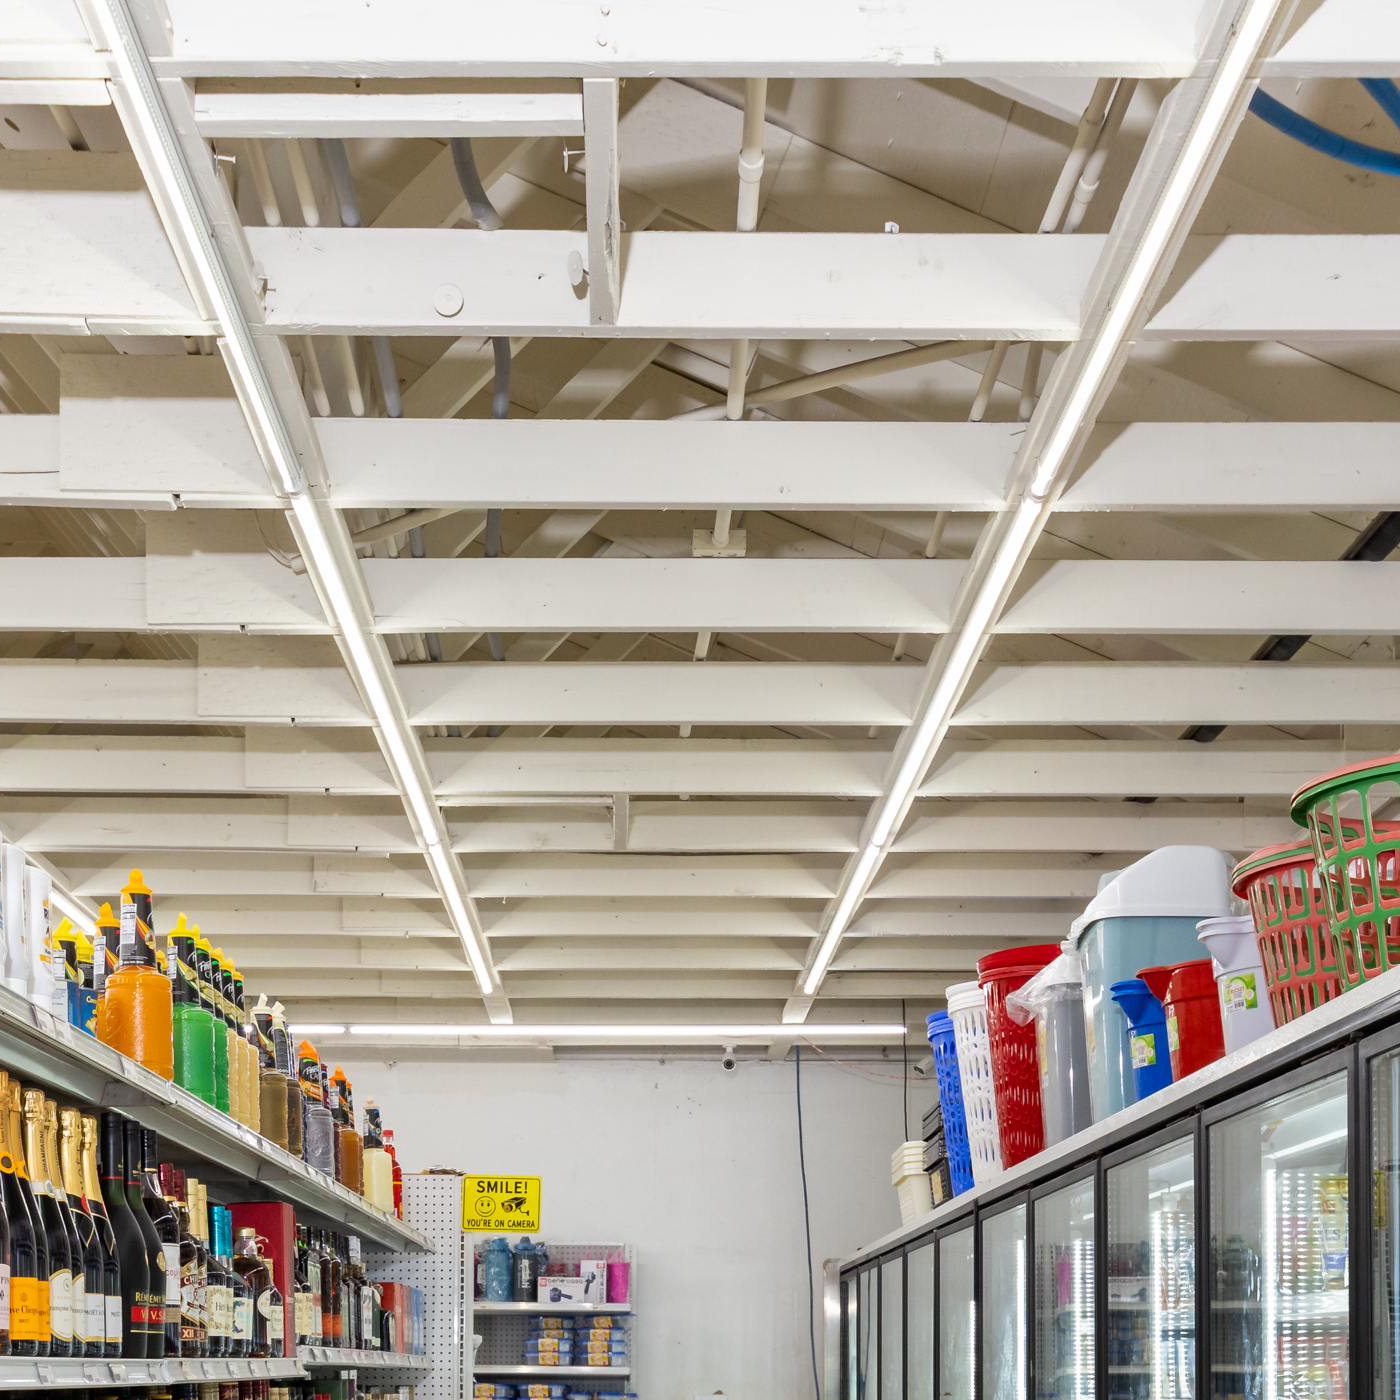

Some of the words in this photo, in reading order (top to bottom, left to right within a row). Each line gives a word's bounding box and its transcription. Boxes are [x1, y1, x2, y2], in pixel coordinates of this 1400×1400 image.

[476, 1180, 528, 1194] SMILE!
[467, 1219, 492, 1228] YOU'RE
[494, 1219, 505, 1228] ON
[507, 1219, 535, 1228] CAMERA
[548, 1277, 565, 1285] bene
